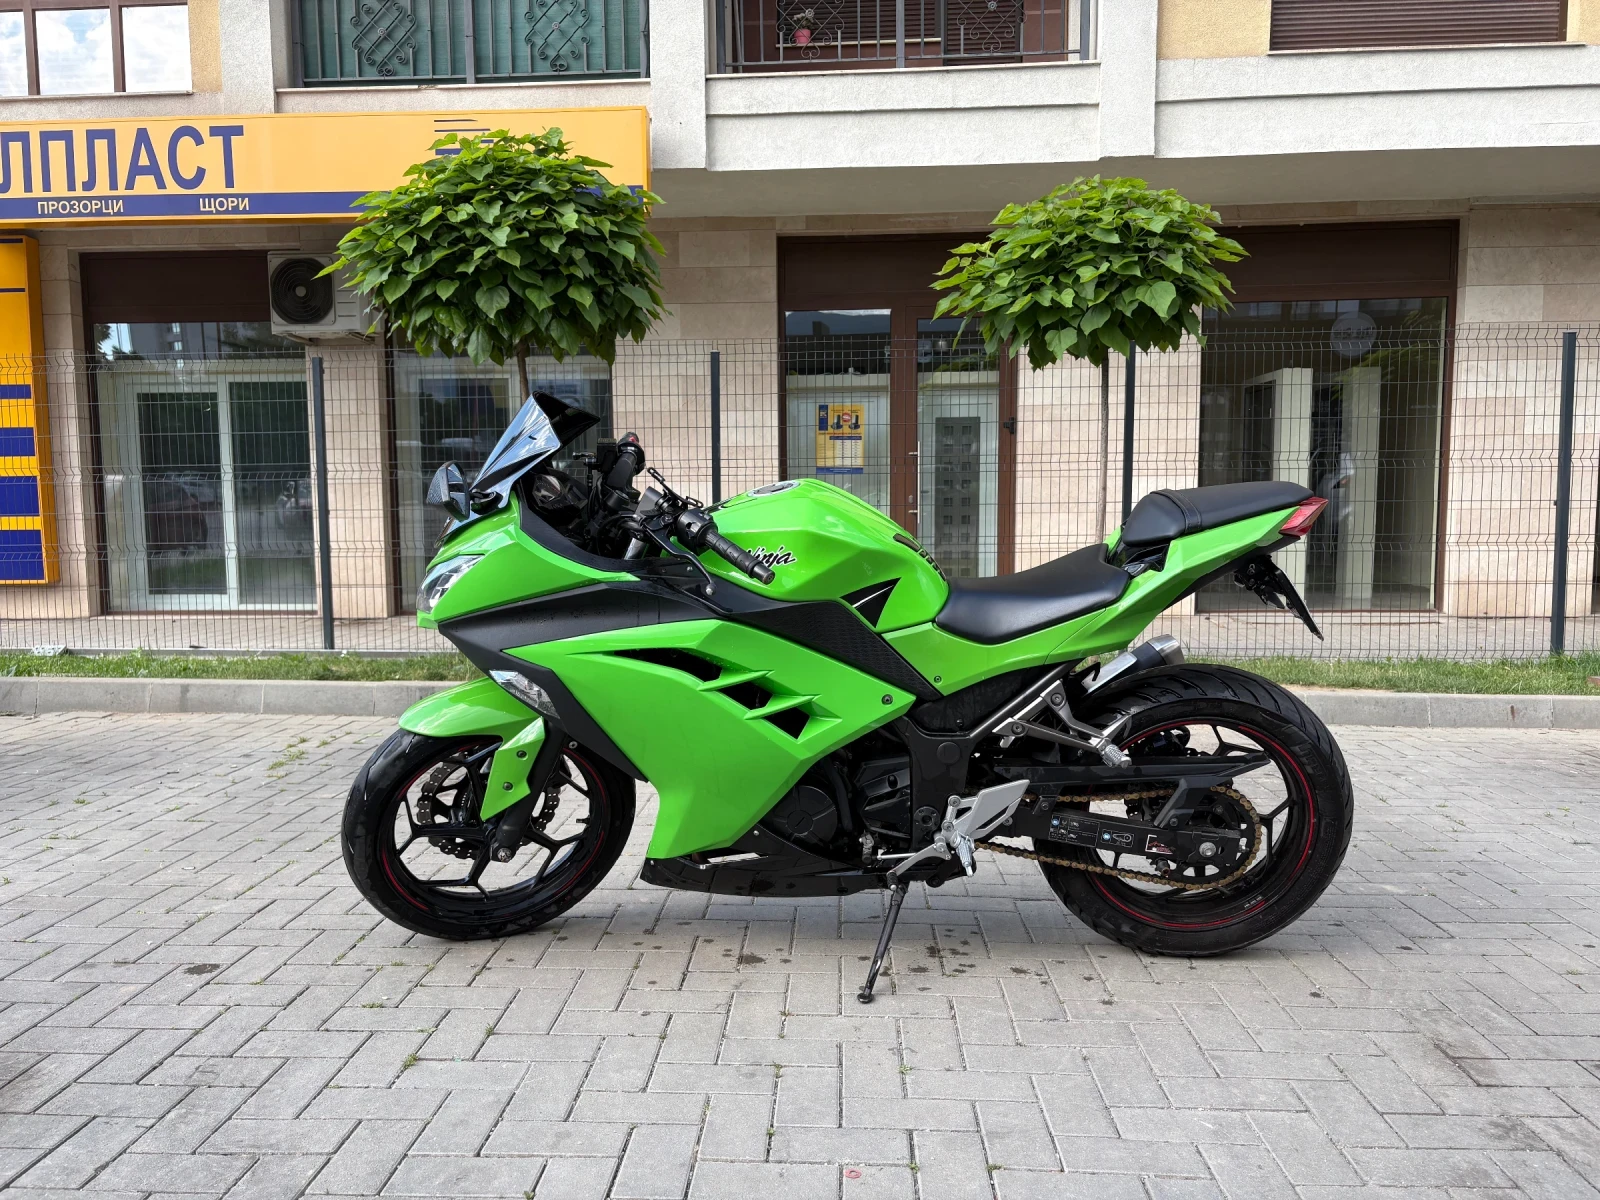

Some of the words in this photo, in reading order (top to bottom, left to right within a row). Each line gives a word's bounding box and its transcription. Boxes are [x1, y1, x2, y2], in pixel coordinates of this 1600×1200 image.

[0, 125, 244, 194] ЛПЛАСТ
[37, 200, 124, 215] ПРОЗОРЦИ
[199, 197, 250, 213] ЩОРИ
